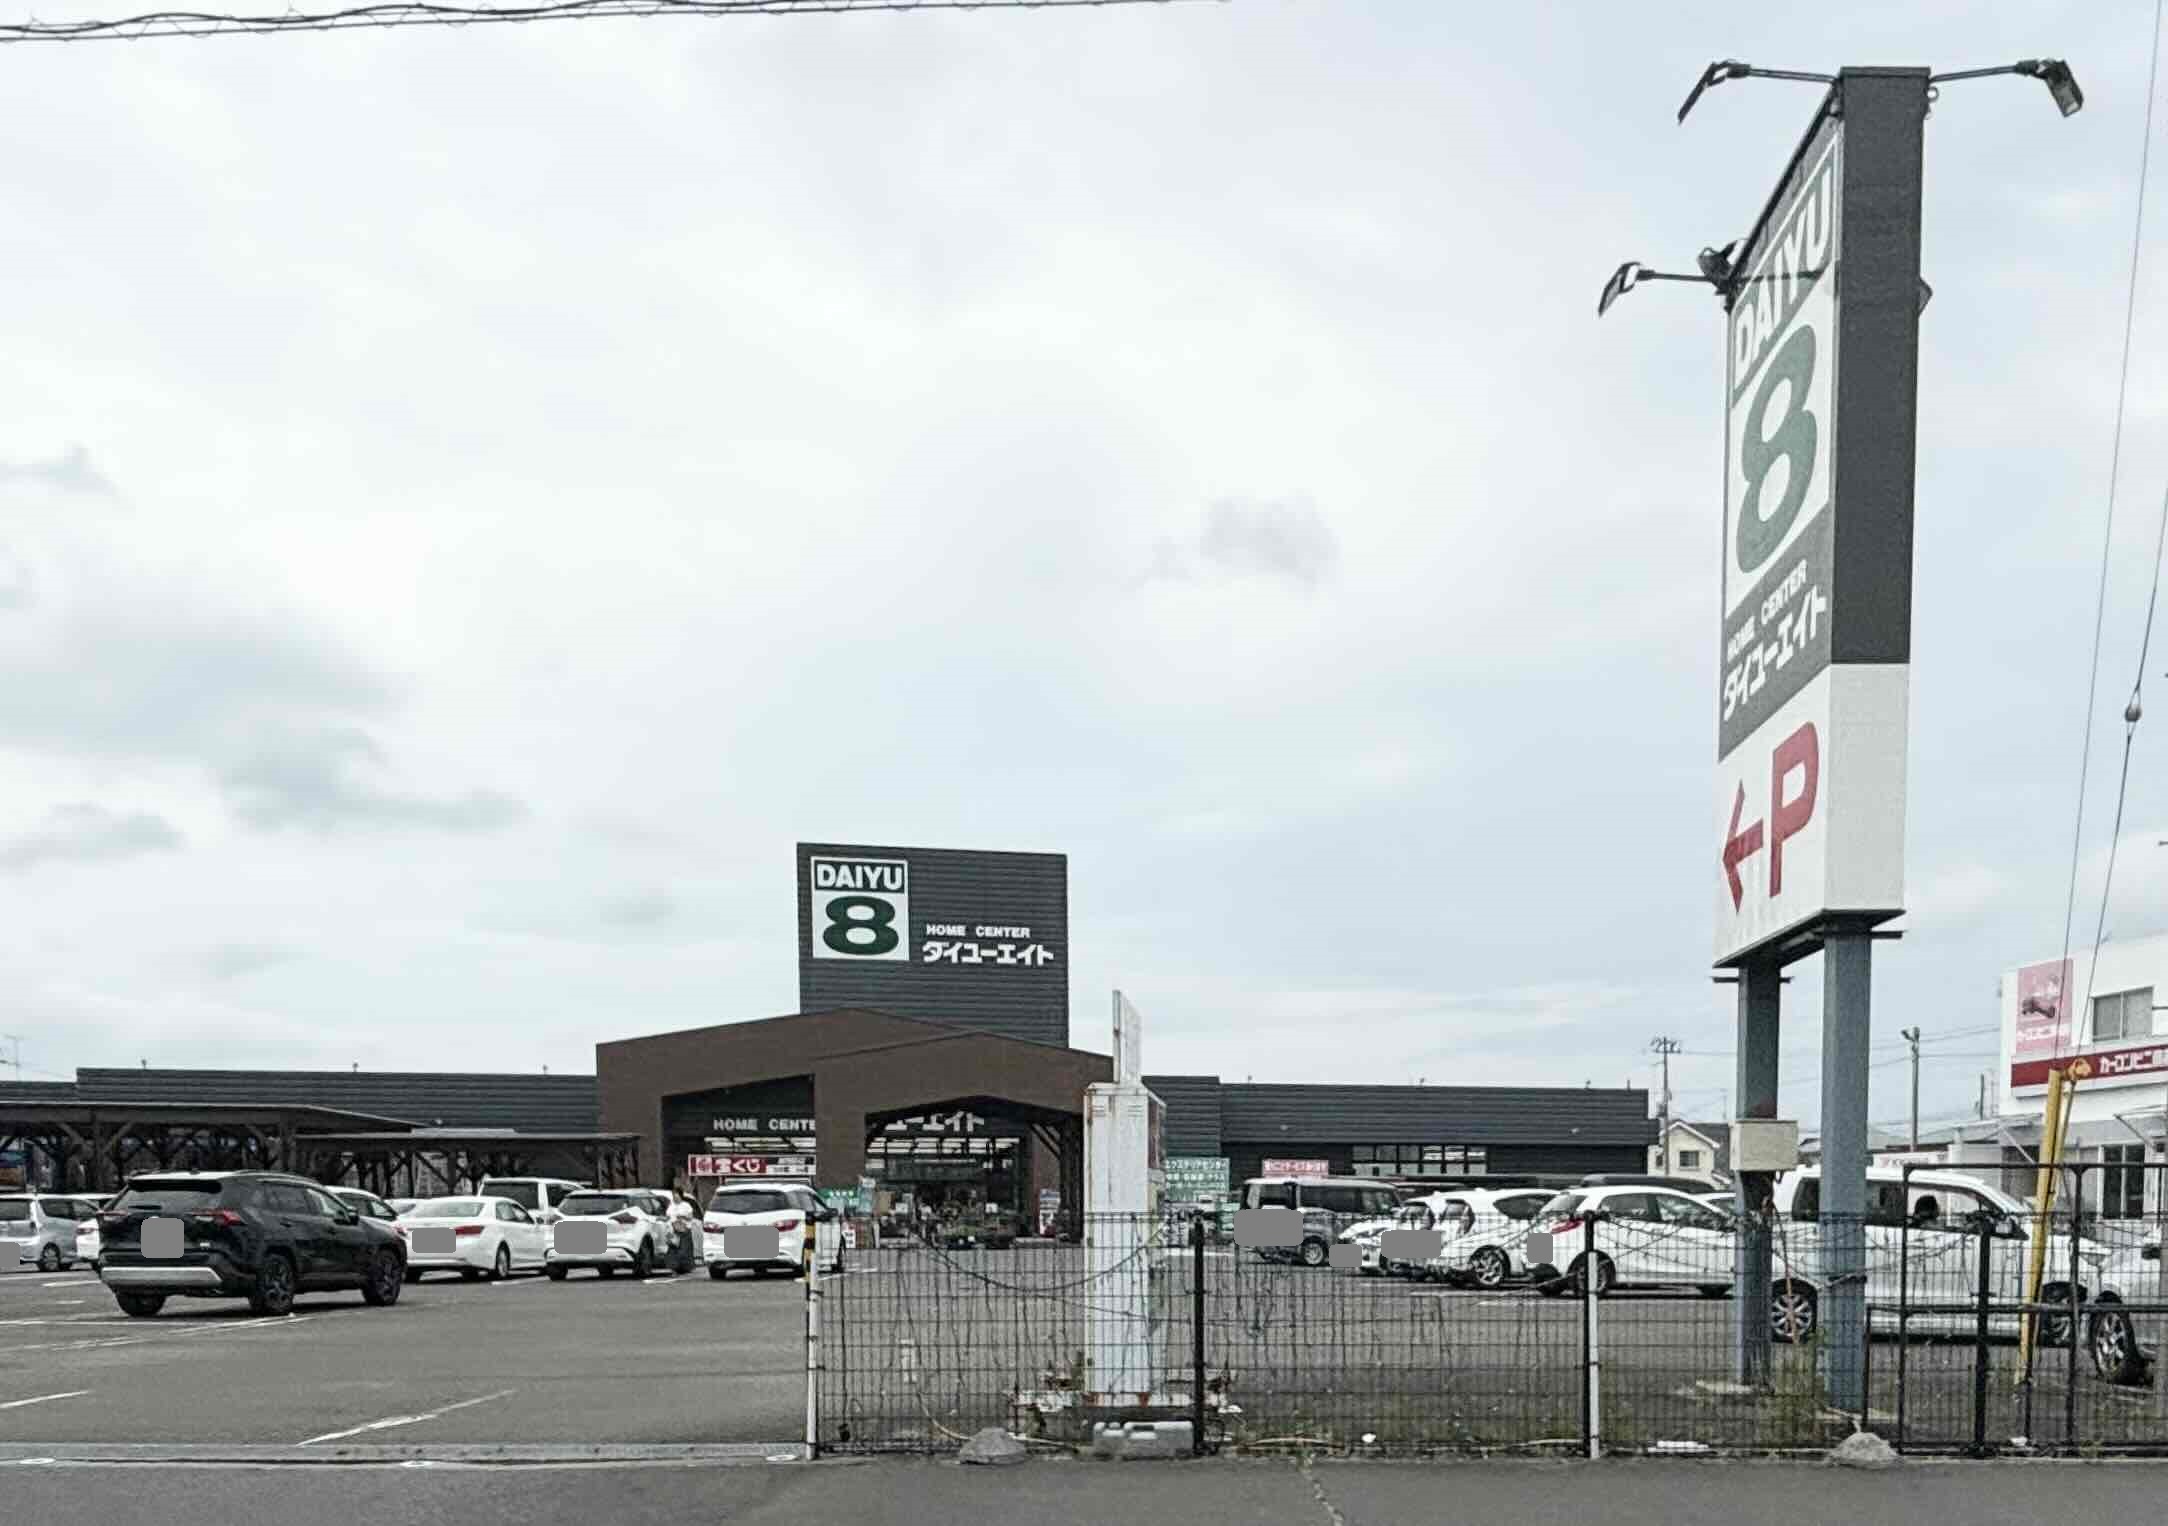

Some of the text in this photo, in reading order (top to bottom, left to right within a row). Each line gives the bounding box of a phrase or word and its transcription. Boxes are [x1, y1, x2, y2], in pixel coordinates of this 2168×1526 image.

[1734, 165, 1832, 390] DAIYU
[1735, 324, 1818, 574] 8
[1726, 557, 1808, 664] HOME CENTER
[1723, 584, 1828, 722] ダイユーエイト
[1768, 721, 1820, 899] P
[815, 863, 903, 890] DAIYU
[822, 895, 900, 956] 8
[922, 940, 1055, 967] ダイユーエイト
[926, 924, 1031, 939] HOME CENTER
[713, 1118, 816, 1131] HOME CENTE
